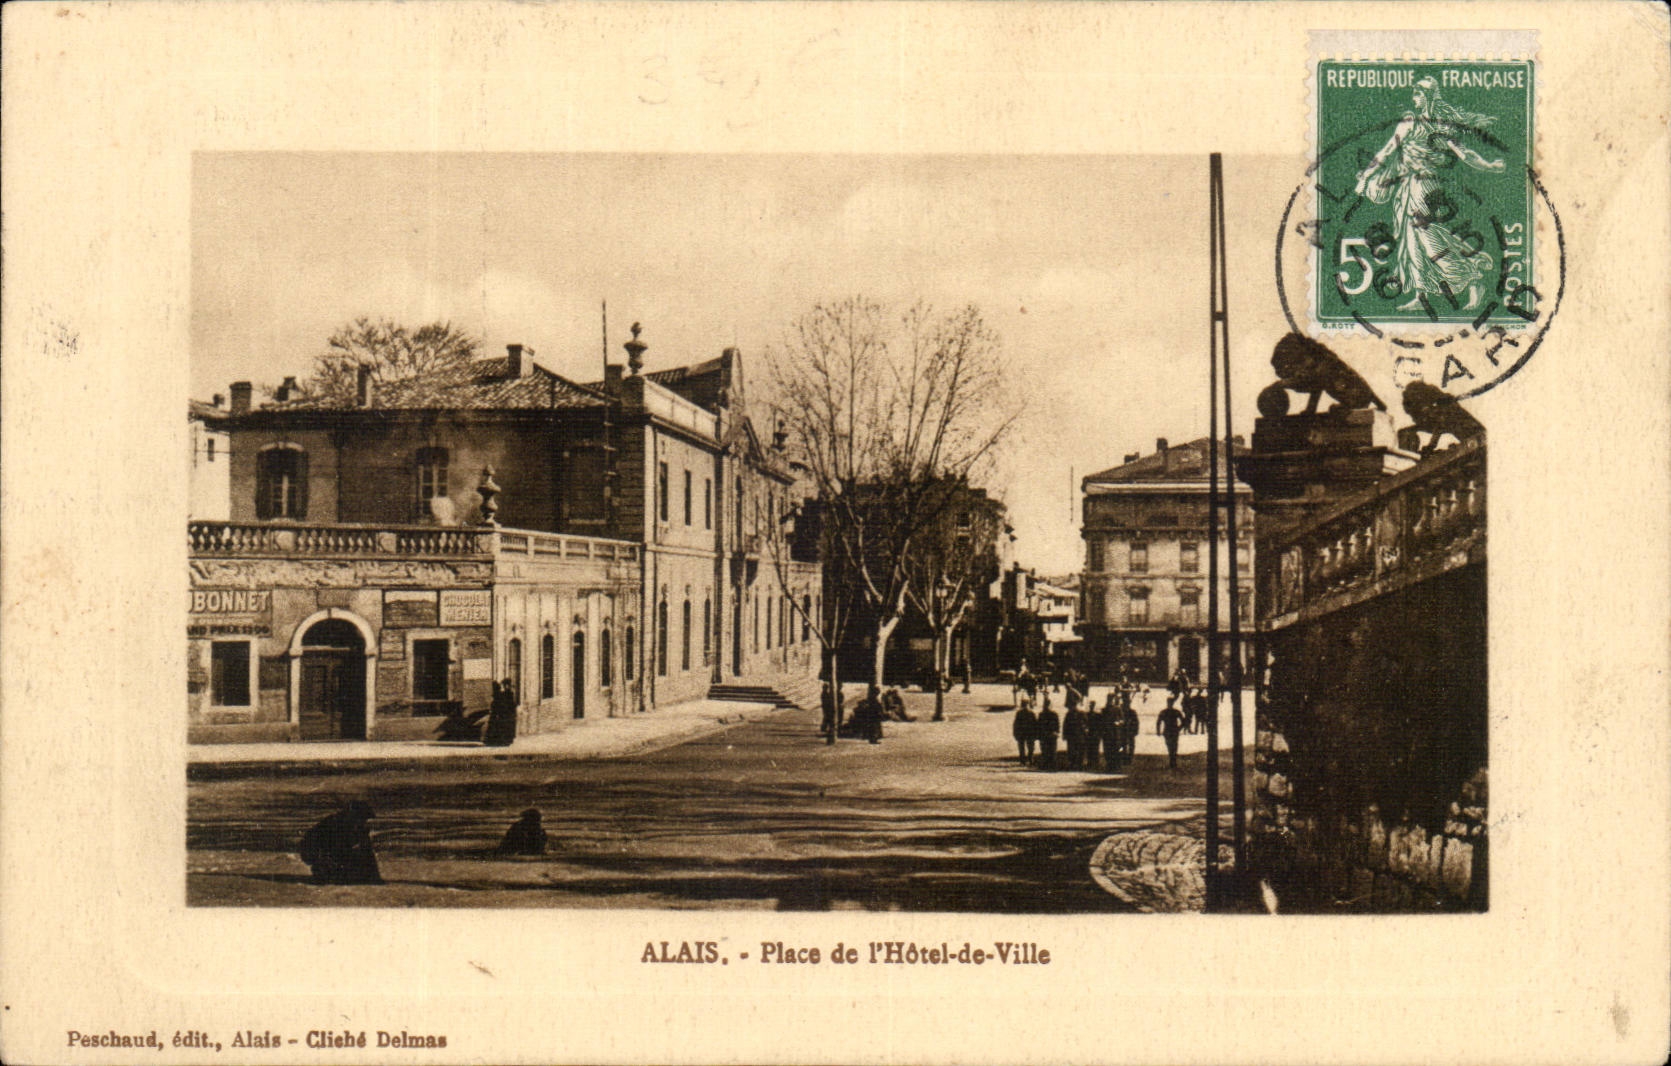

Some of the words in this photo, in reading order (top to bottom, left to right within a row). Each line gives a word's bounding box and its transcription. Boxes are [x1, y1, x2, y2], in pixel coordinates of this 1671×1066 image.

[1327, 69, 1415, 89] REPUBLIQUE
[1442, 69, 1525, 91] FRANÇAISE
[1503, 222, 1523, 309] POSTES
